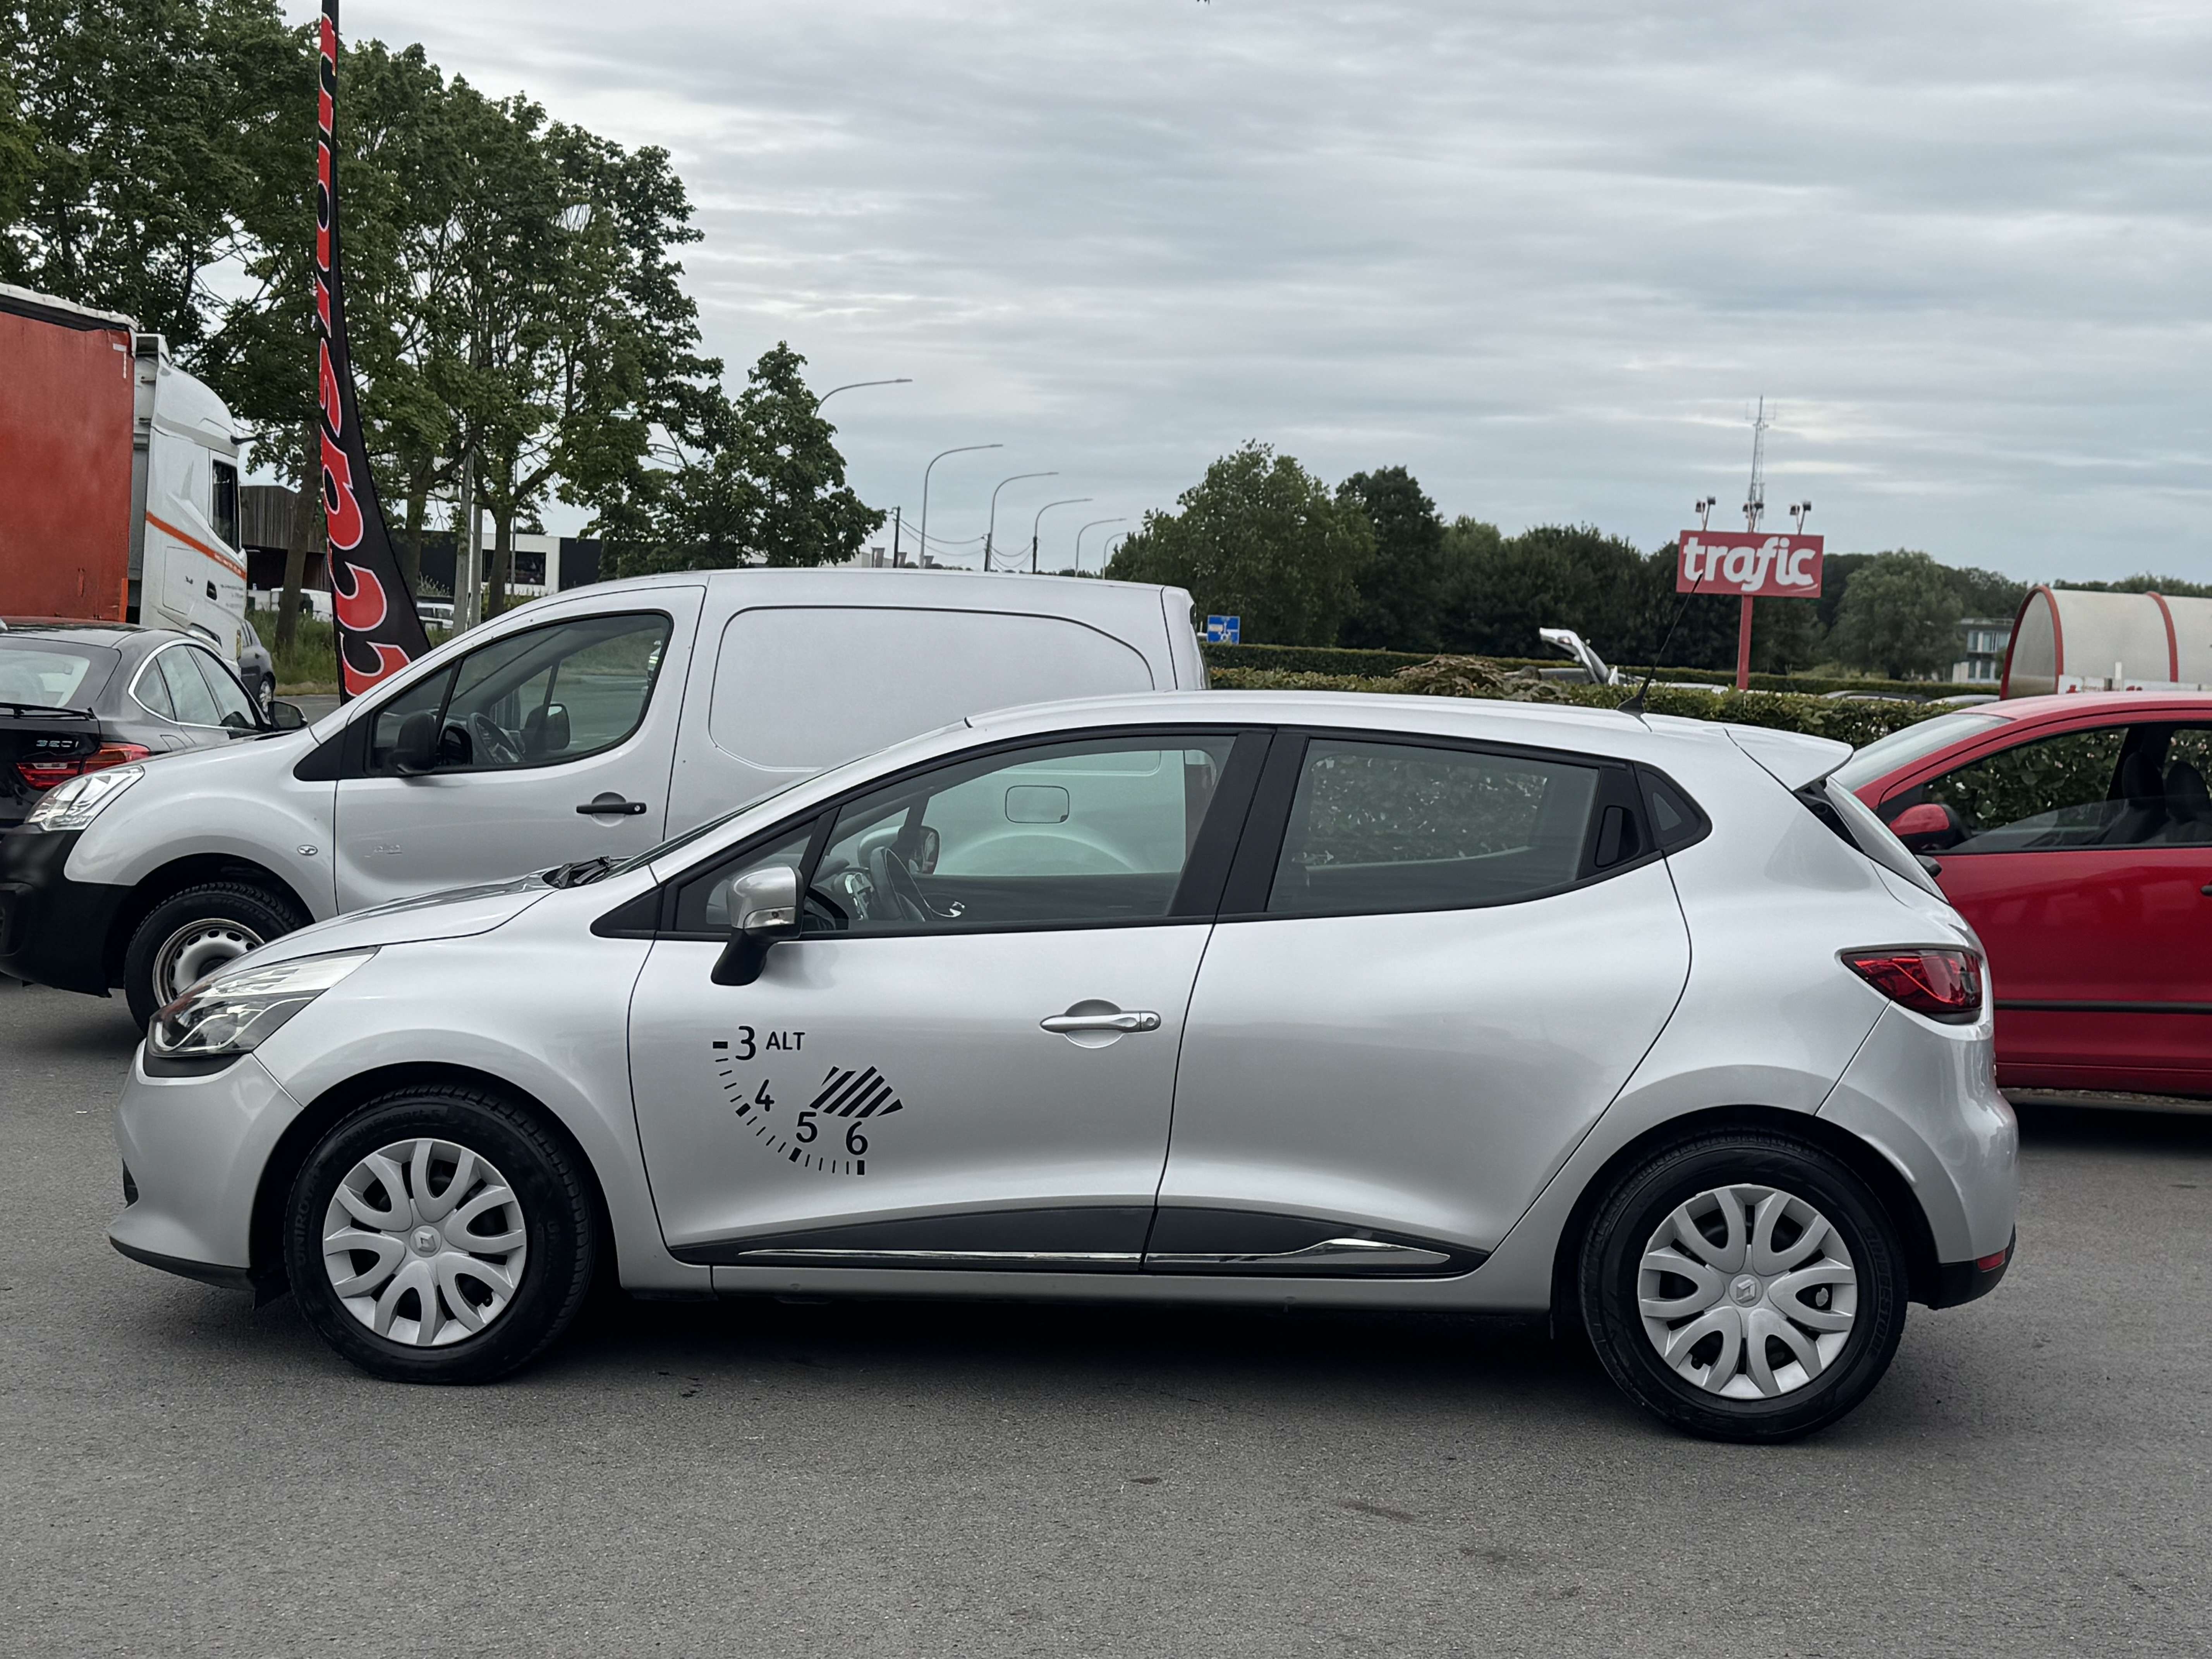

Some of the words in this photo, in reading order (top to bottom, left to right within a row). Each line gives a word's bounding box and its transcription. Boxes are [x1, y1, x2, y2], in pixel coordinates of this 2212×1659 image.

[1683, 536, 1816, 592] trafic
[735, 1025, 757, 1061] 3
[765, 1031, 805, 1051] ALT
[754, 1079, 775, 1112] 4
[795, 1111, 818, 1143] 5
[845, 1121, 868, 1156] 6
